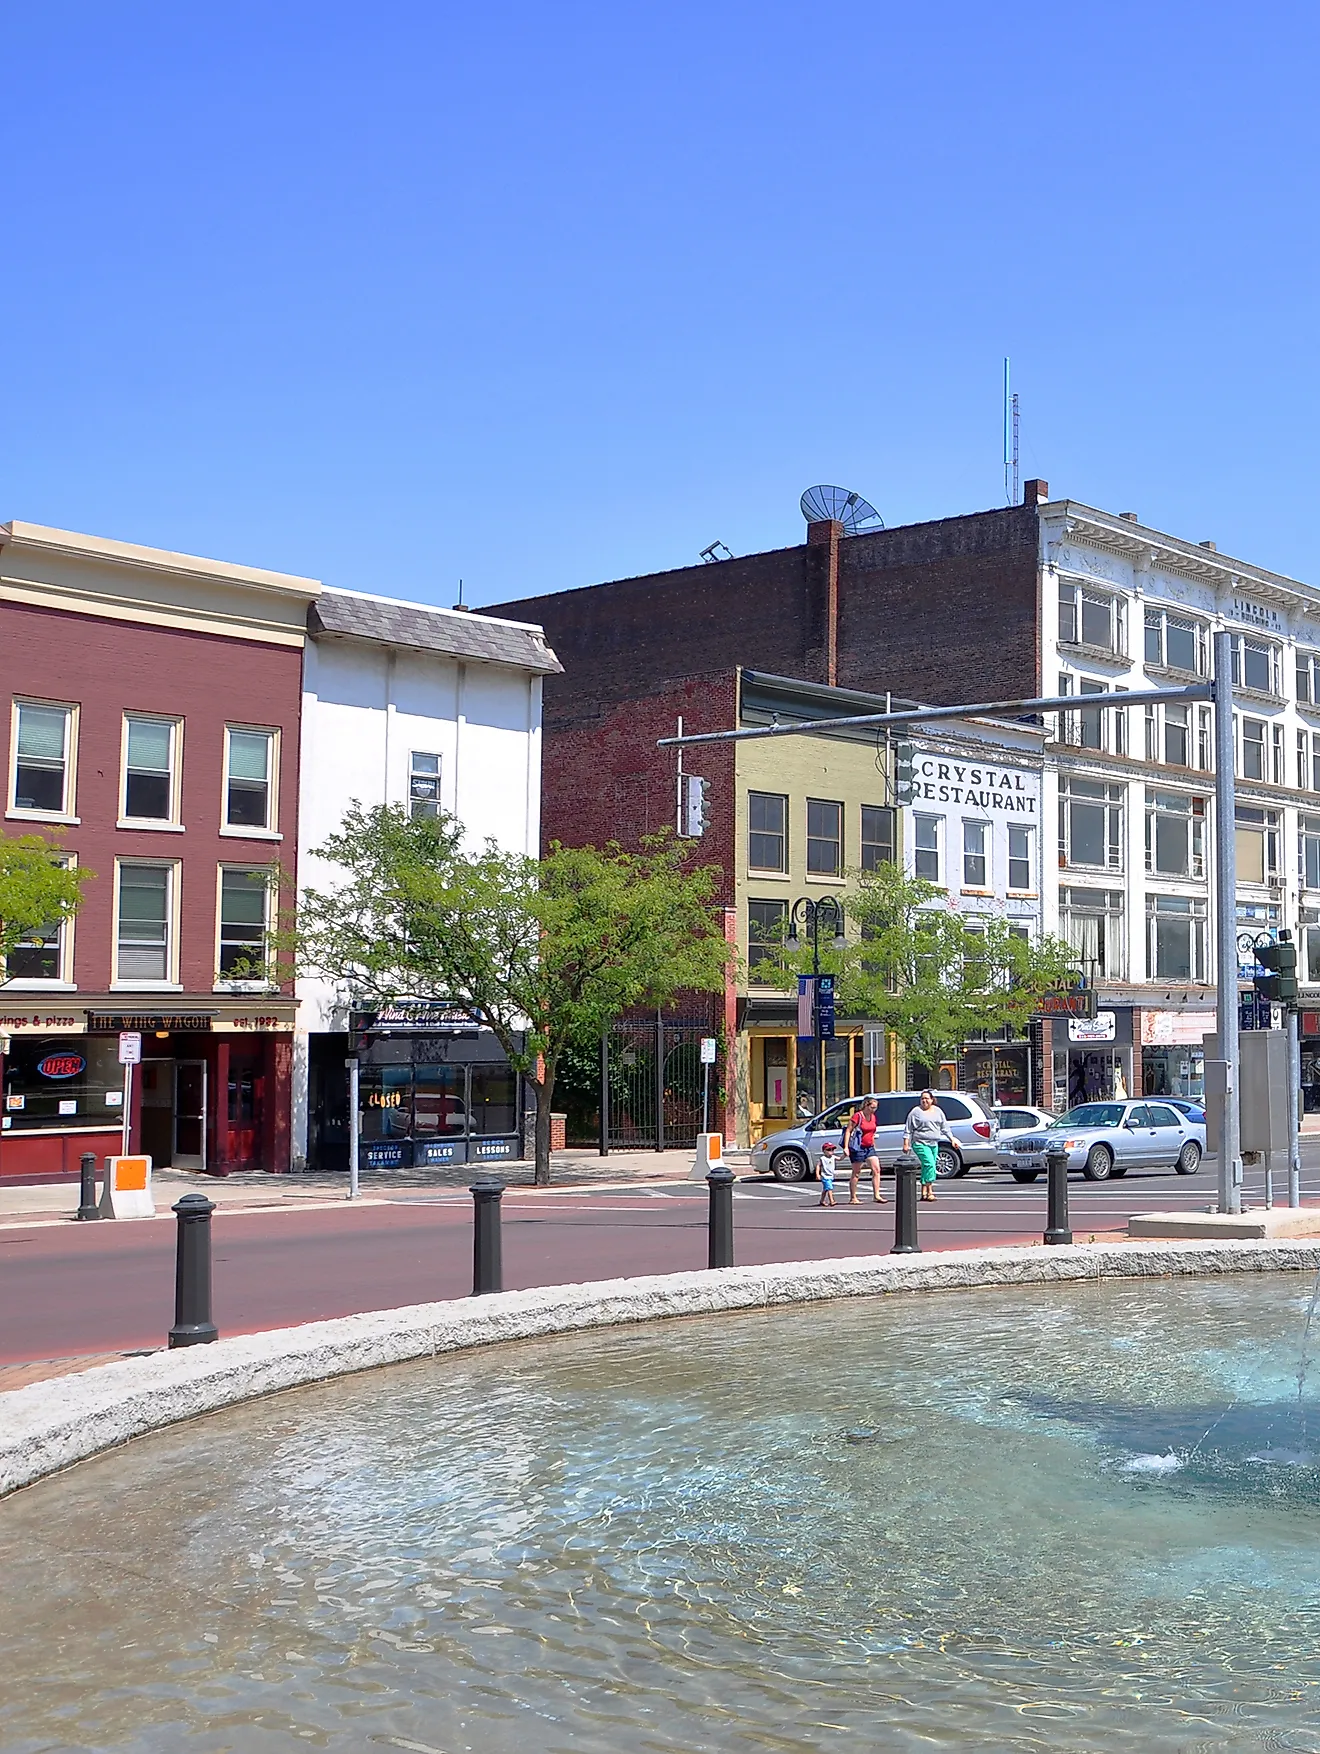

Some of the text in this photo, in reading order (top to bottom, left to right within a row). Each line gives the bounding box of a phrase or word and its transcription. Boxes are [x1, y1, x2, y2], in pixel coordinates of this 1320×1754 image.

[1234, 598, 1277, 621] LINCOLN
[922, 761, 1025, 790] CRYSTAL
[33, 1015, 41, 1026] &
[45, 1015, 75, 1028] pizza
[92, 1016, 212, 1029] THE WING WAGON
[43, 1057, 82, 1075] OPEN
[369, 1091, 401, 1108] CLOSED
[367, 1150, 402, 1160] SERVICE
[427, 1148, 453, 1158] SALES
[476, 1145, 511, 1155] LESSONS
